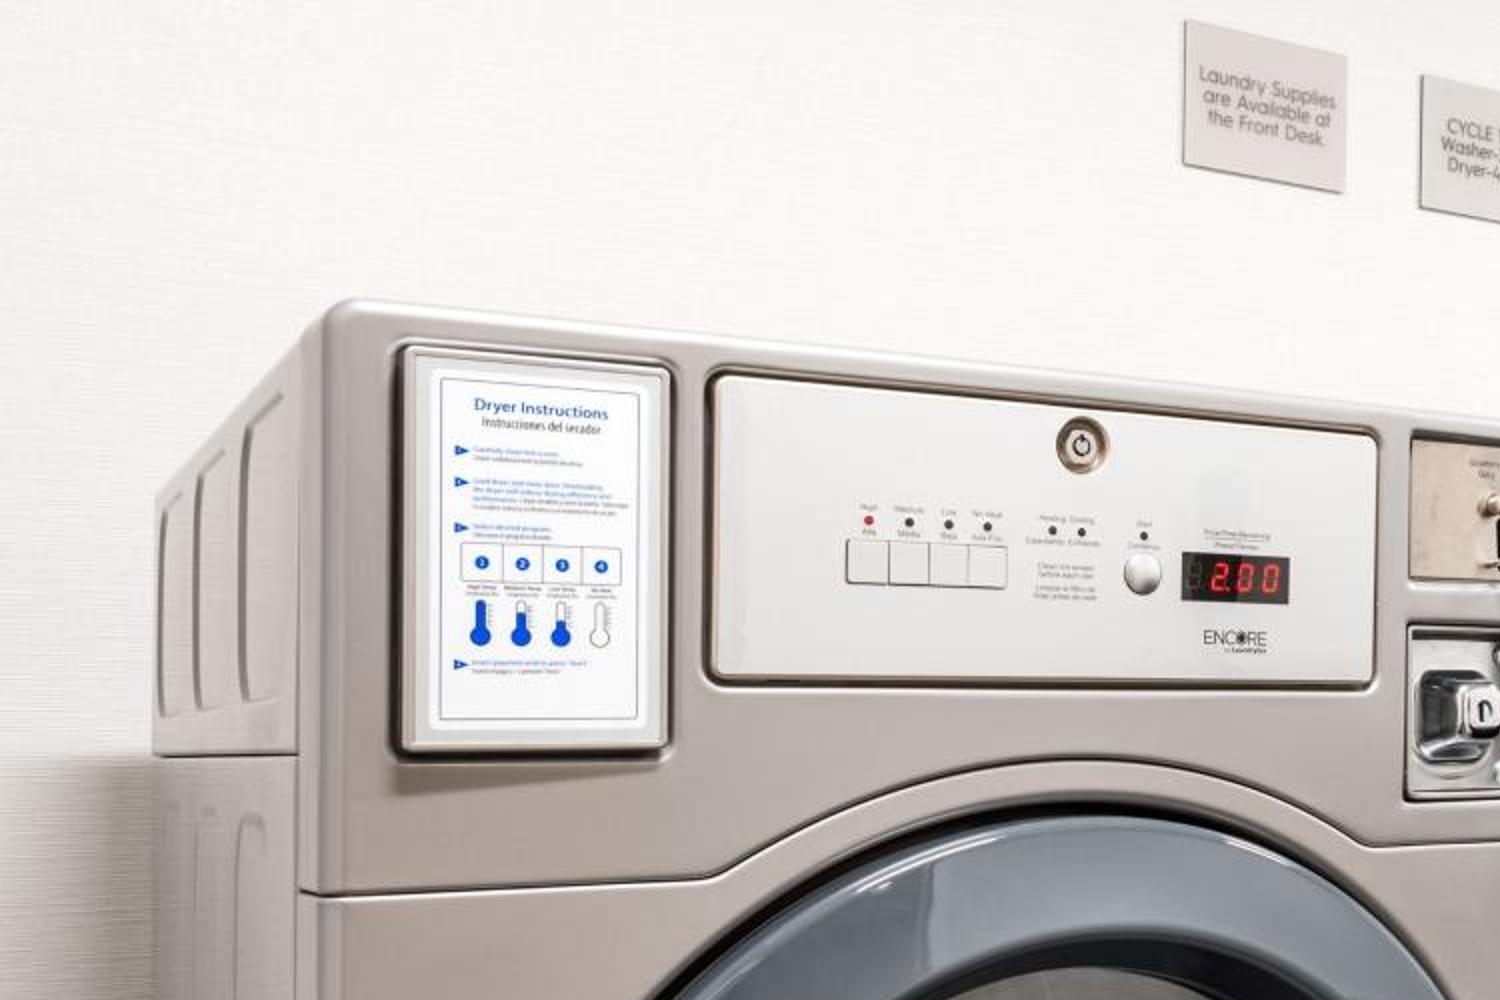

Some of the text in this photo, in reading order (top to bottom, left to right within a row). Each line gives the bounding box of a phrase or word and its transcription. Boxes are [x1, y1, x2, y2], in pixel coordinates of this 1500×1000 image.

[1199, 65, 1336, 109] Laundry Supplies
[1203, 90, 1331, 127] are Available at
[1208, 110, 1233, 128] the
[1239, 115, 1279, 137] Front
[1447, 118, 1493, 142] CYCLE
[474, 398, 609, 420] Dryer Instructions
[1203, 630, 1267, 646] ENCORE
